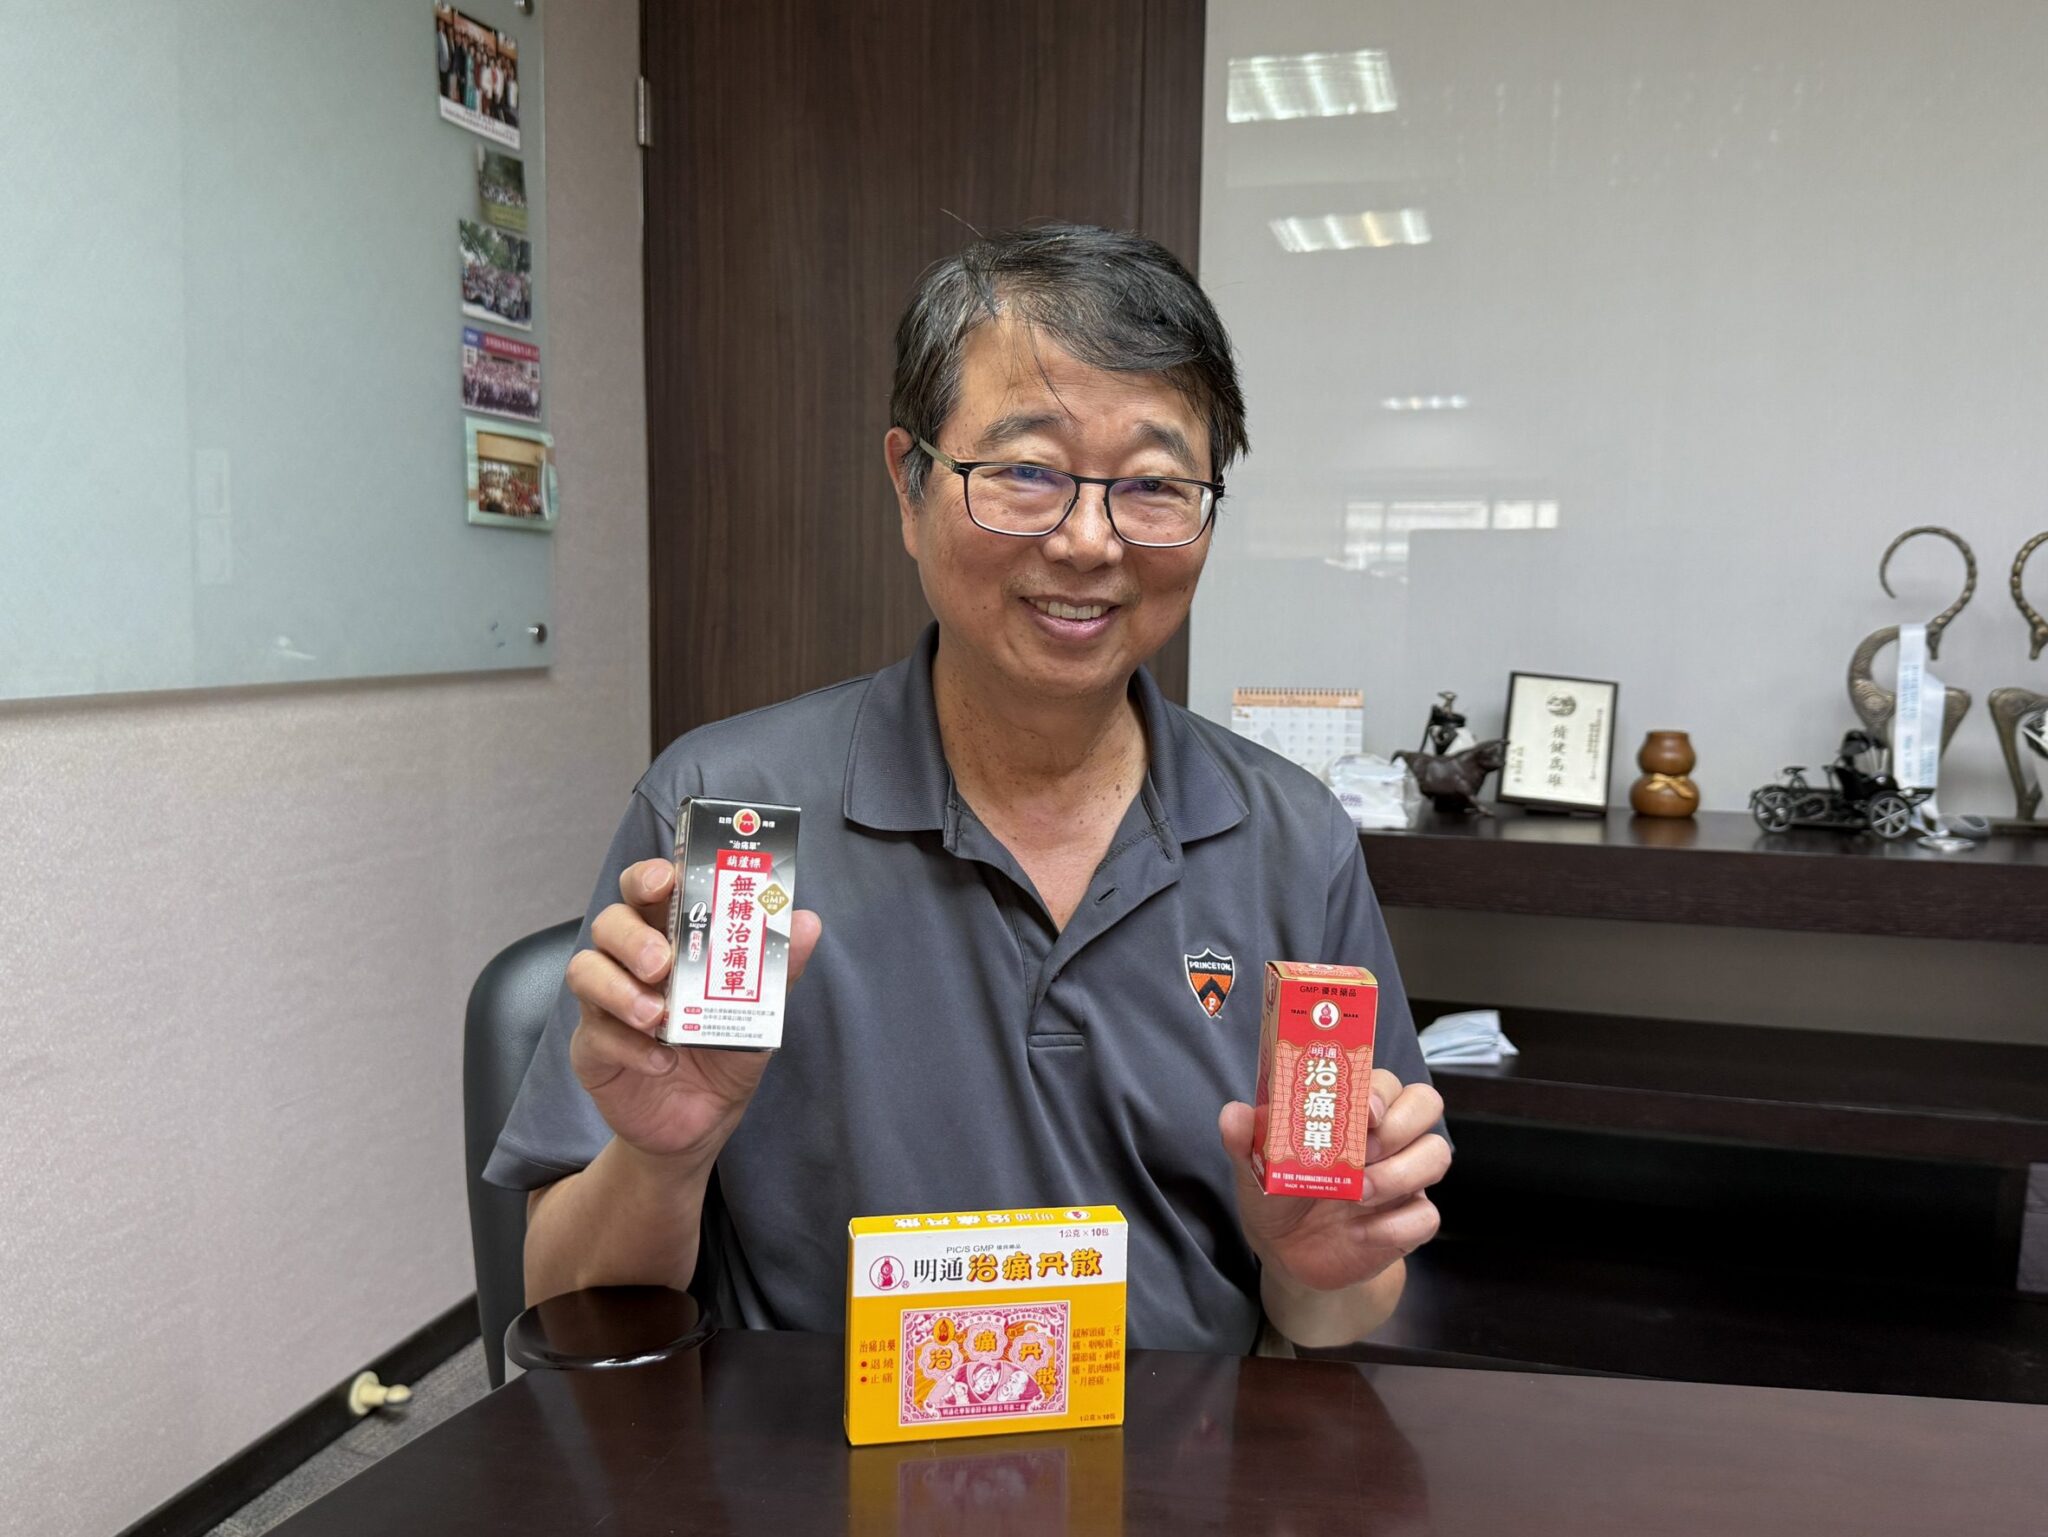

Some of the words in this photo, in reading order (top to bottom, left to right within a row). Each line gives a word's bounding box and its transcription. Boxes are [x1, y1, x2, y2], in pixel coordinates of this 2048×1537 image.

[762, 895, 785, 904] GMP
[721, 874, 757, 995] 無糖治痛單
[1189, 961, 1232, 971] PRINCETON
[1322, 987, 1357, 997] 優良藥品
[1311, 1046, 1337, 1058] 明通
[1303, 1059, 1339, 1151] 治痛單
[1091, 1228, 1109, 1237] 10包
[946, 1245, 971, 1254] PIC/S
[973, 1244, 994, 1253] GMP
[871, 1373, 893, 1384] 止痛
